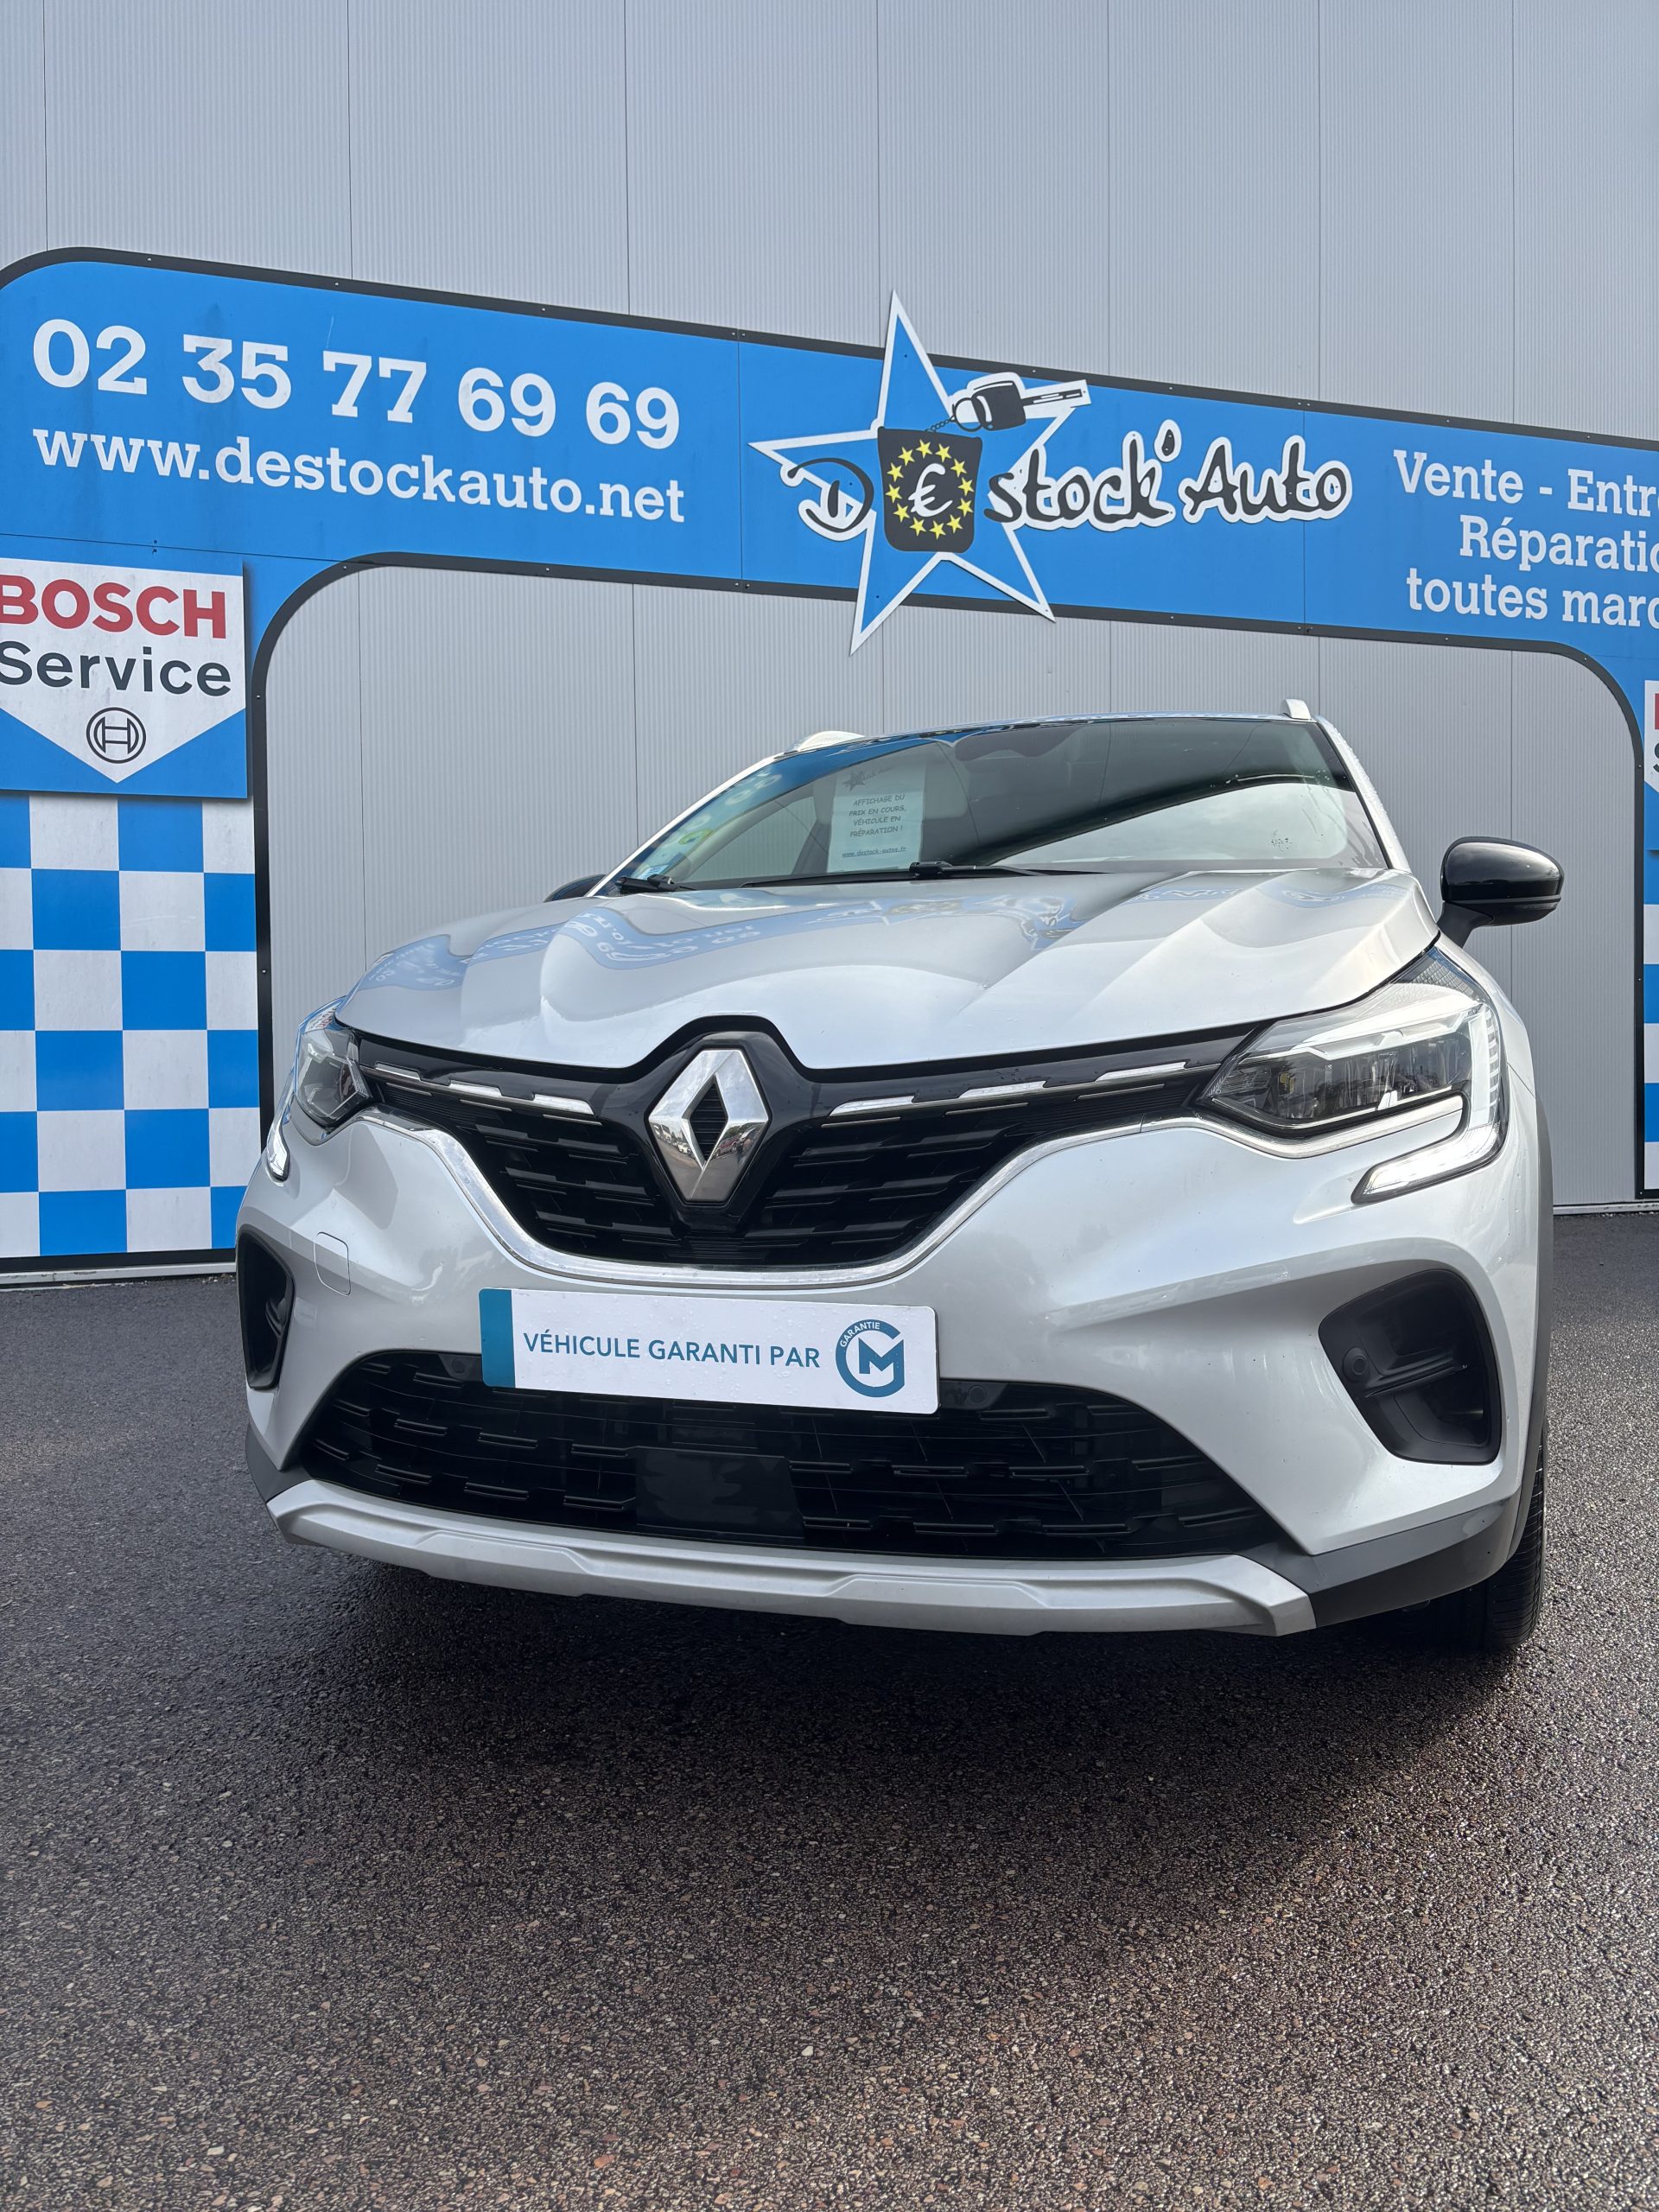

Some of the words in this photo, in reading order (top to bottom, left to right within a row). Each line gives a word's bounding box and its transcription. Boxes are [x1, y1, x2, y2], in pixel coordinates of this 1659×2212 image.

[33, 319, 148, 396] 02
[181, 334, 292, 410] 35
[322, 350, 427, 423] 77
[458, 367, 556, 437] 69
[586, 381, 680, 449] 69
[32, 429, 685, 523] www.destockauto.net
[1393, 448, 1523, 504] Vente
[1567, 468, 1659, 518] Entr
[0, 575, 226, 639] BOSCH
[1406, 568, 1548, 620] toutes
[0, 640, 232, 696] Service
[853, 796, 893, 806] AFFICHAGE
[854, 817, 888, 826] VÉHICULE
[849, 826, 899, 837] PRÉPARATION
[523, 1329, 640, 1358] VÉHICULE
[648, 1339, 760, 1366] GARANTI
[770, 1345, 820, 1369] PAR
[839, 1321, 880, 1347] GARANTIE
